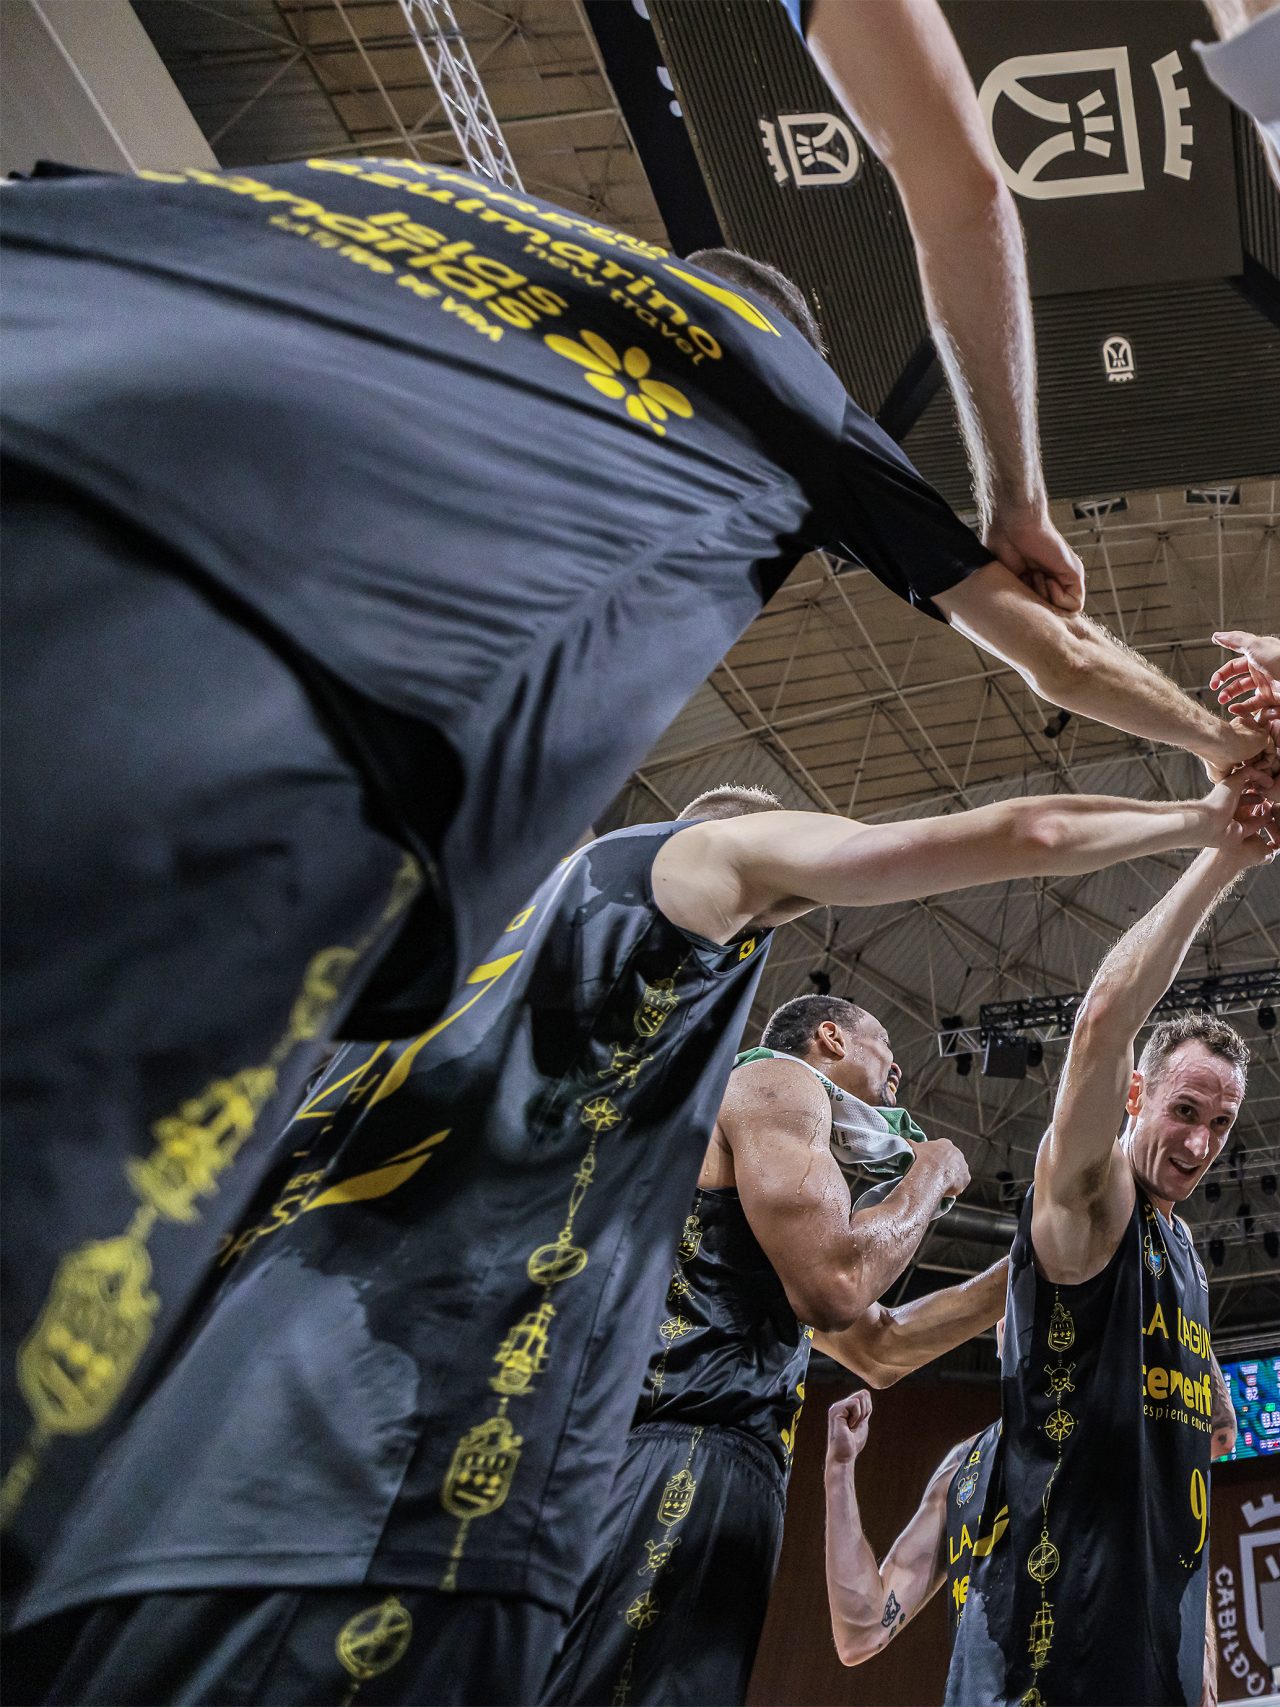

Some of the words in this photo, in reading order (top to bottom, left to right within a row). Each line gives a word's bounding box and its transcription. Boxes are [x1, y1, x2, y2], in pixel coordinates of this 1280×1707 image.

[367, 211, 571, 318] Islas
[1142, 1302, 1169, 1339] A
[949, 1523, 973, 1565] LA
[1190, 1468, 1207, 1554] 9
[1215, 1564, 1266, 1697] CABILDO
